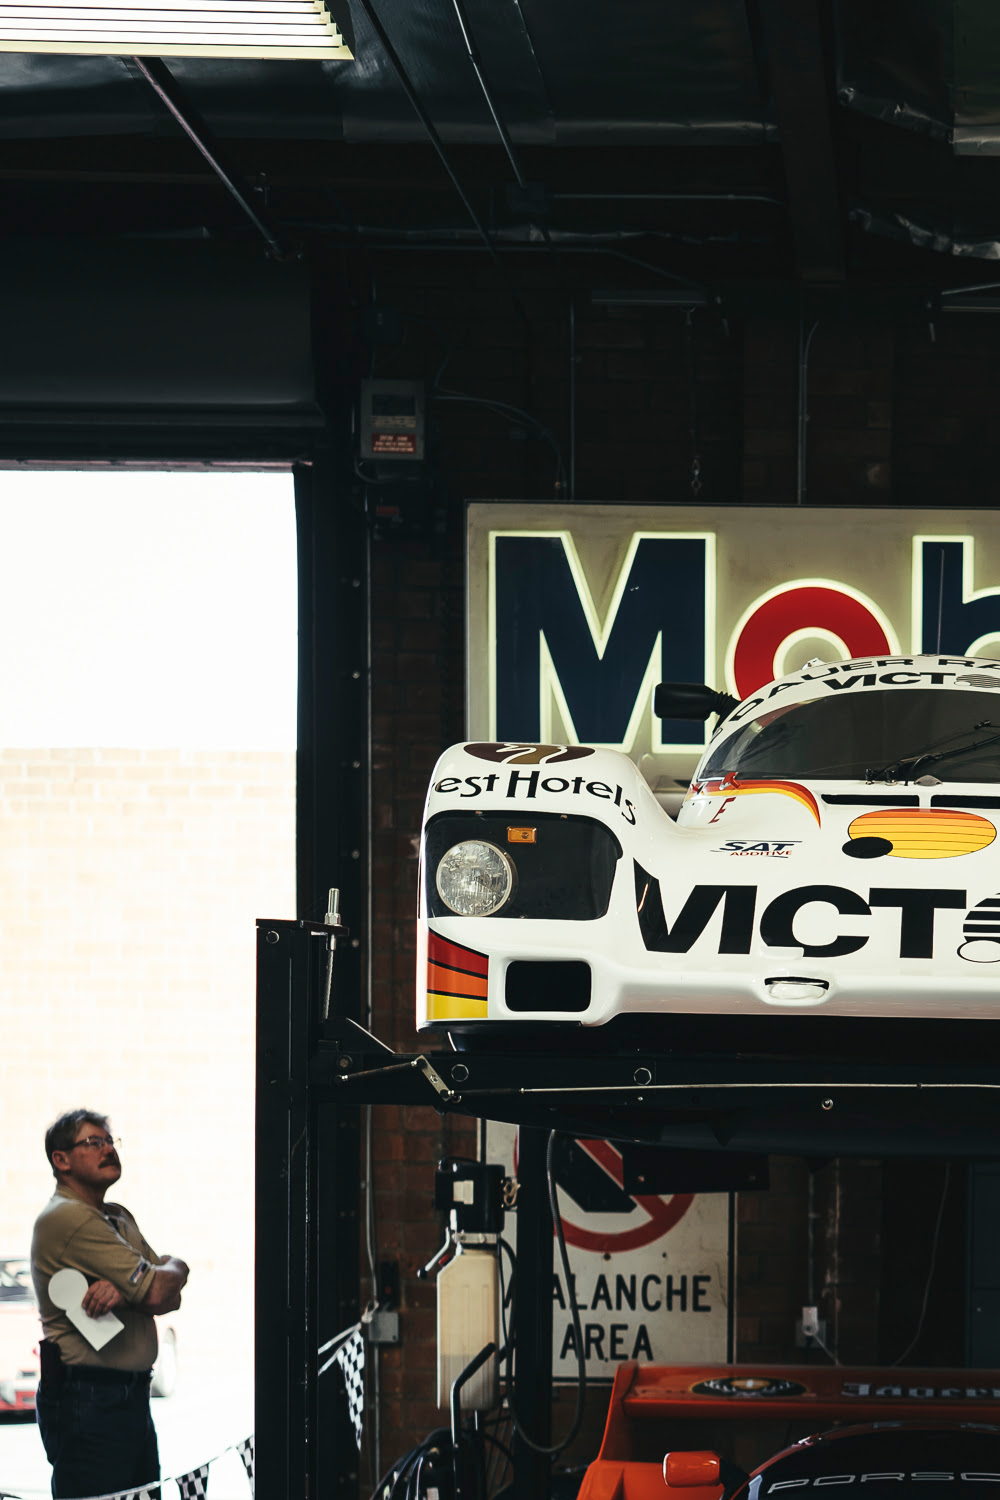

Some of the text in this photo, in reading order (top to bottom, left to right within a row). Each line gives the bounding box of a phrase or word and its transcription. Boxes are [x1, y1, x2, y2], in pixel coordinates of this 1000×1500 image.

[729, 659, 914, 722] DAUER
[431, 770, 636, 826] est Hotels
[720, 841, 794, 852] SAT
[504, 1273, 711, 1312] ALANCHE
[560, 1323, 654, 1361] AREA
